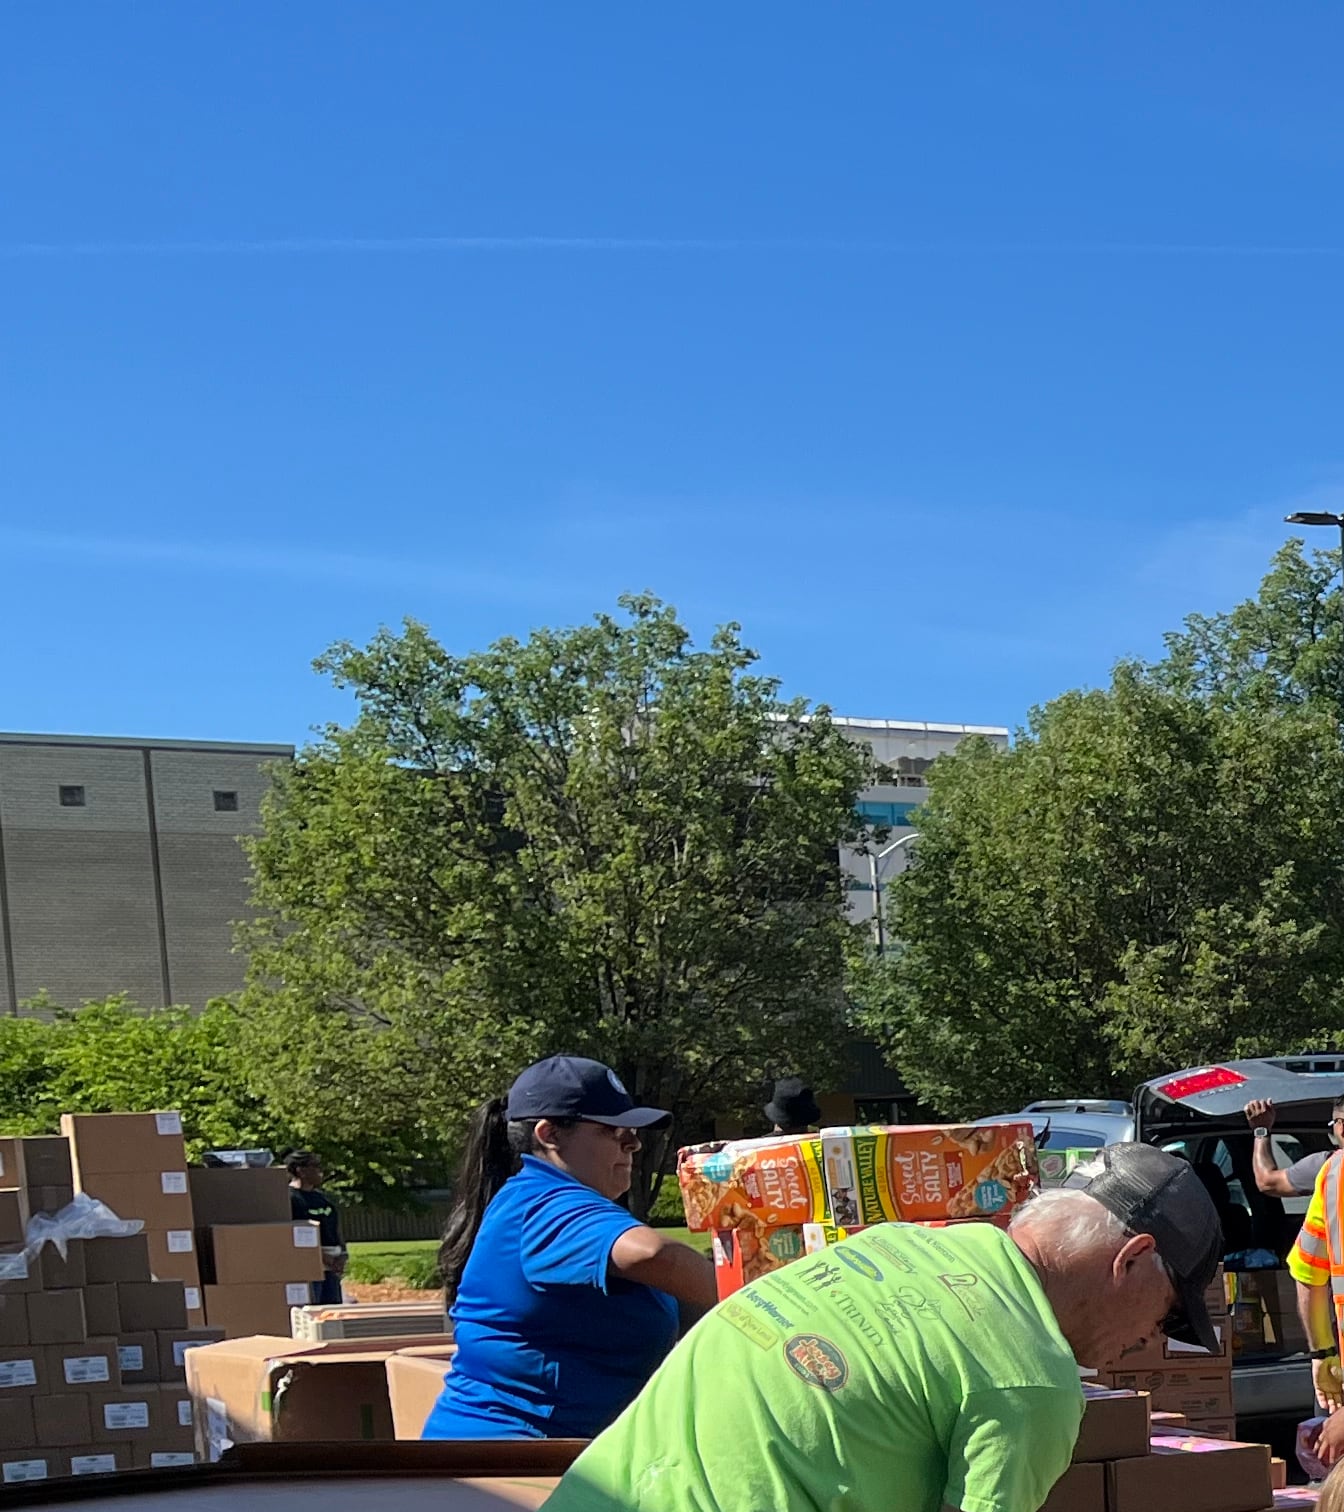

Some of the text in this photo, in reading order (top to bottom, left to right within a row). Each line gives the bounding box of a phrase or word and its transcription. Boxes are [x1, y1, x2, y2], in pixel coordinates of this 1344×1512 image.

[760, 1158, 785, 1209] SALTY
[858, 1179, 882, 1222] NATURE
[920, 1151, 942, 1202] SALTY
[837, 1293, 884, 1348] TRINITY
